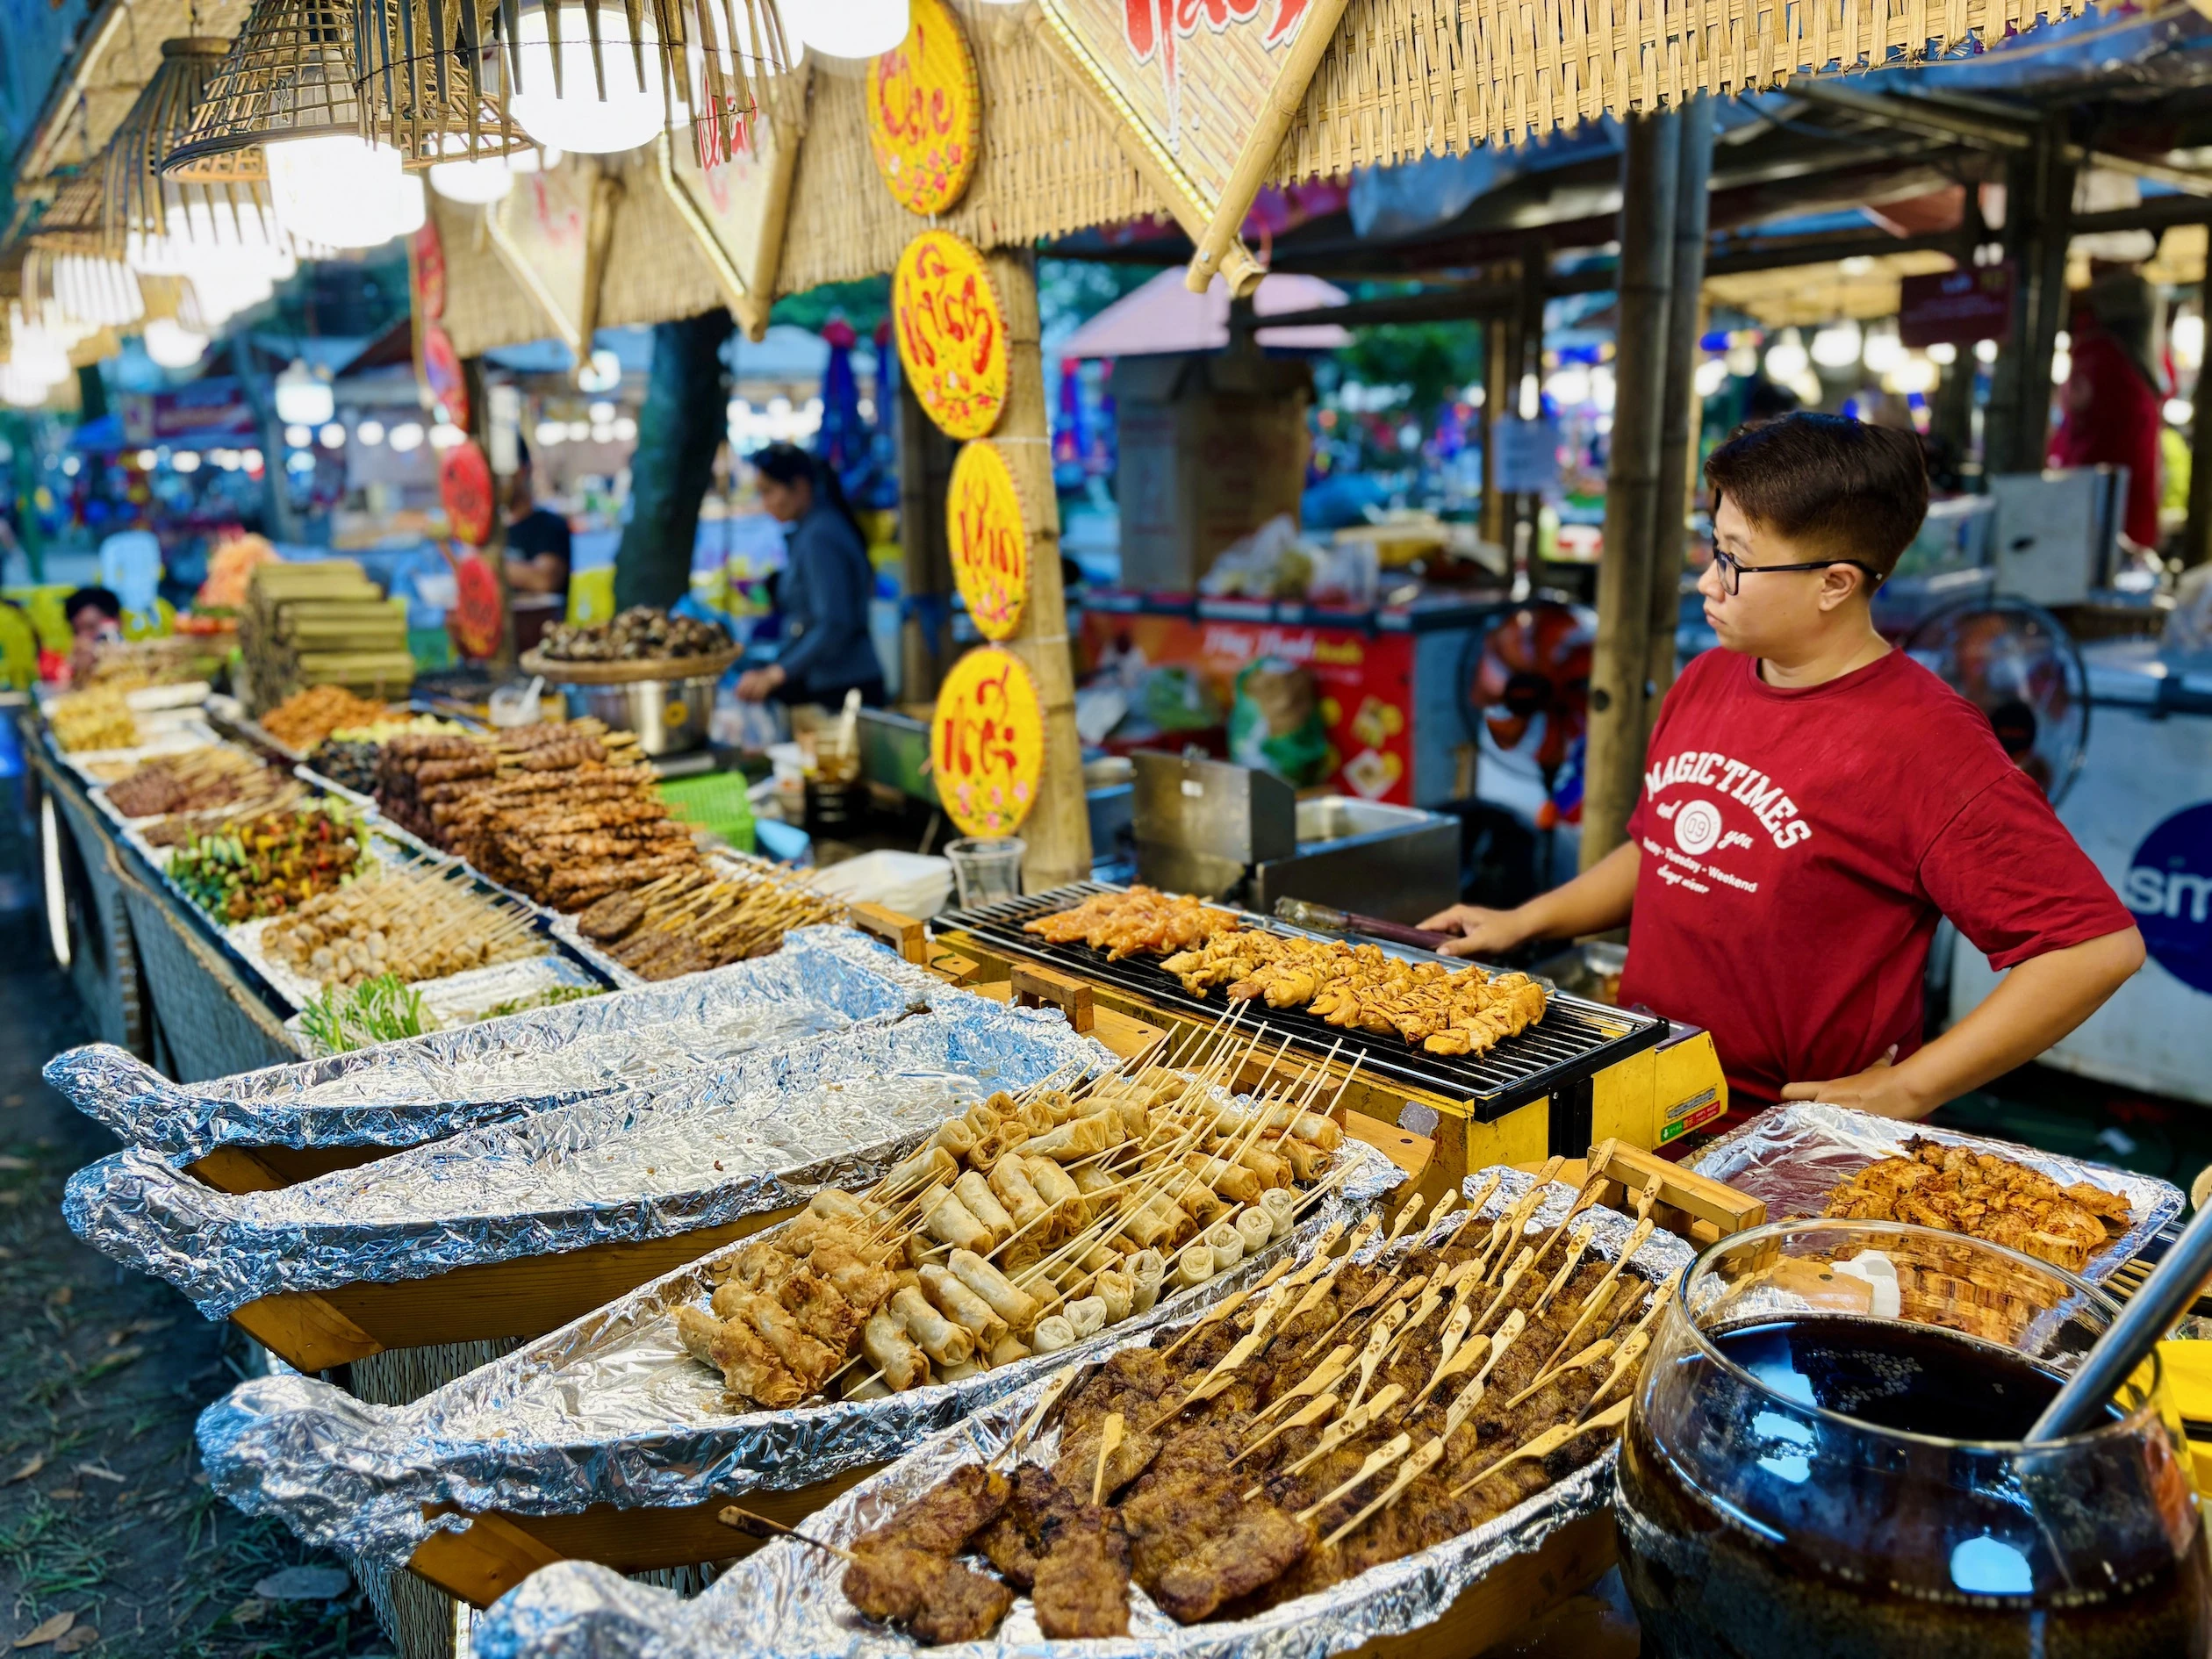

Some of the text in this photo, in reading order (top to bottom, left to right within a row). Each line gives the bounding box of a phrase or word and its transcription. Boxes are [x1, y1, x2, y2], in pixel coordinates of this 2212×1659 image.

[1715, 758, 1813, 850] TIMES
[1687, 817, 1706, 837] 09
[1717, 830, 1754, 850] you
[1664, 847, 1702, 874] Tuesday
[1708, 865, 1759, 894] Weekend
